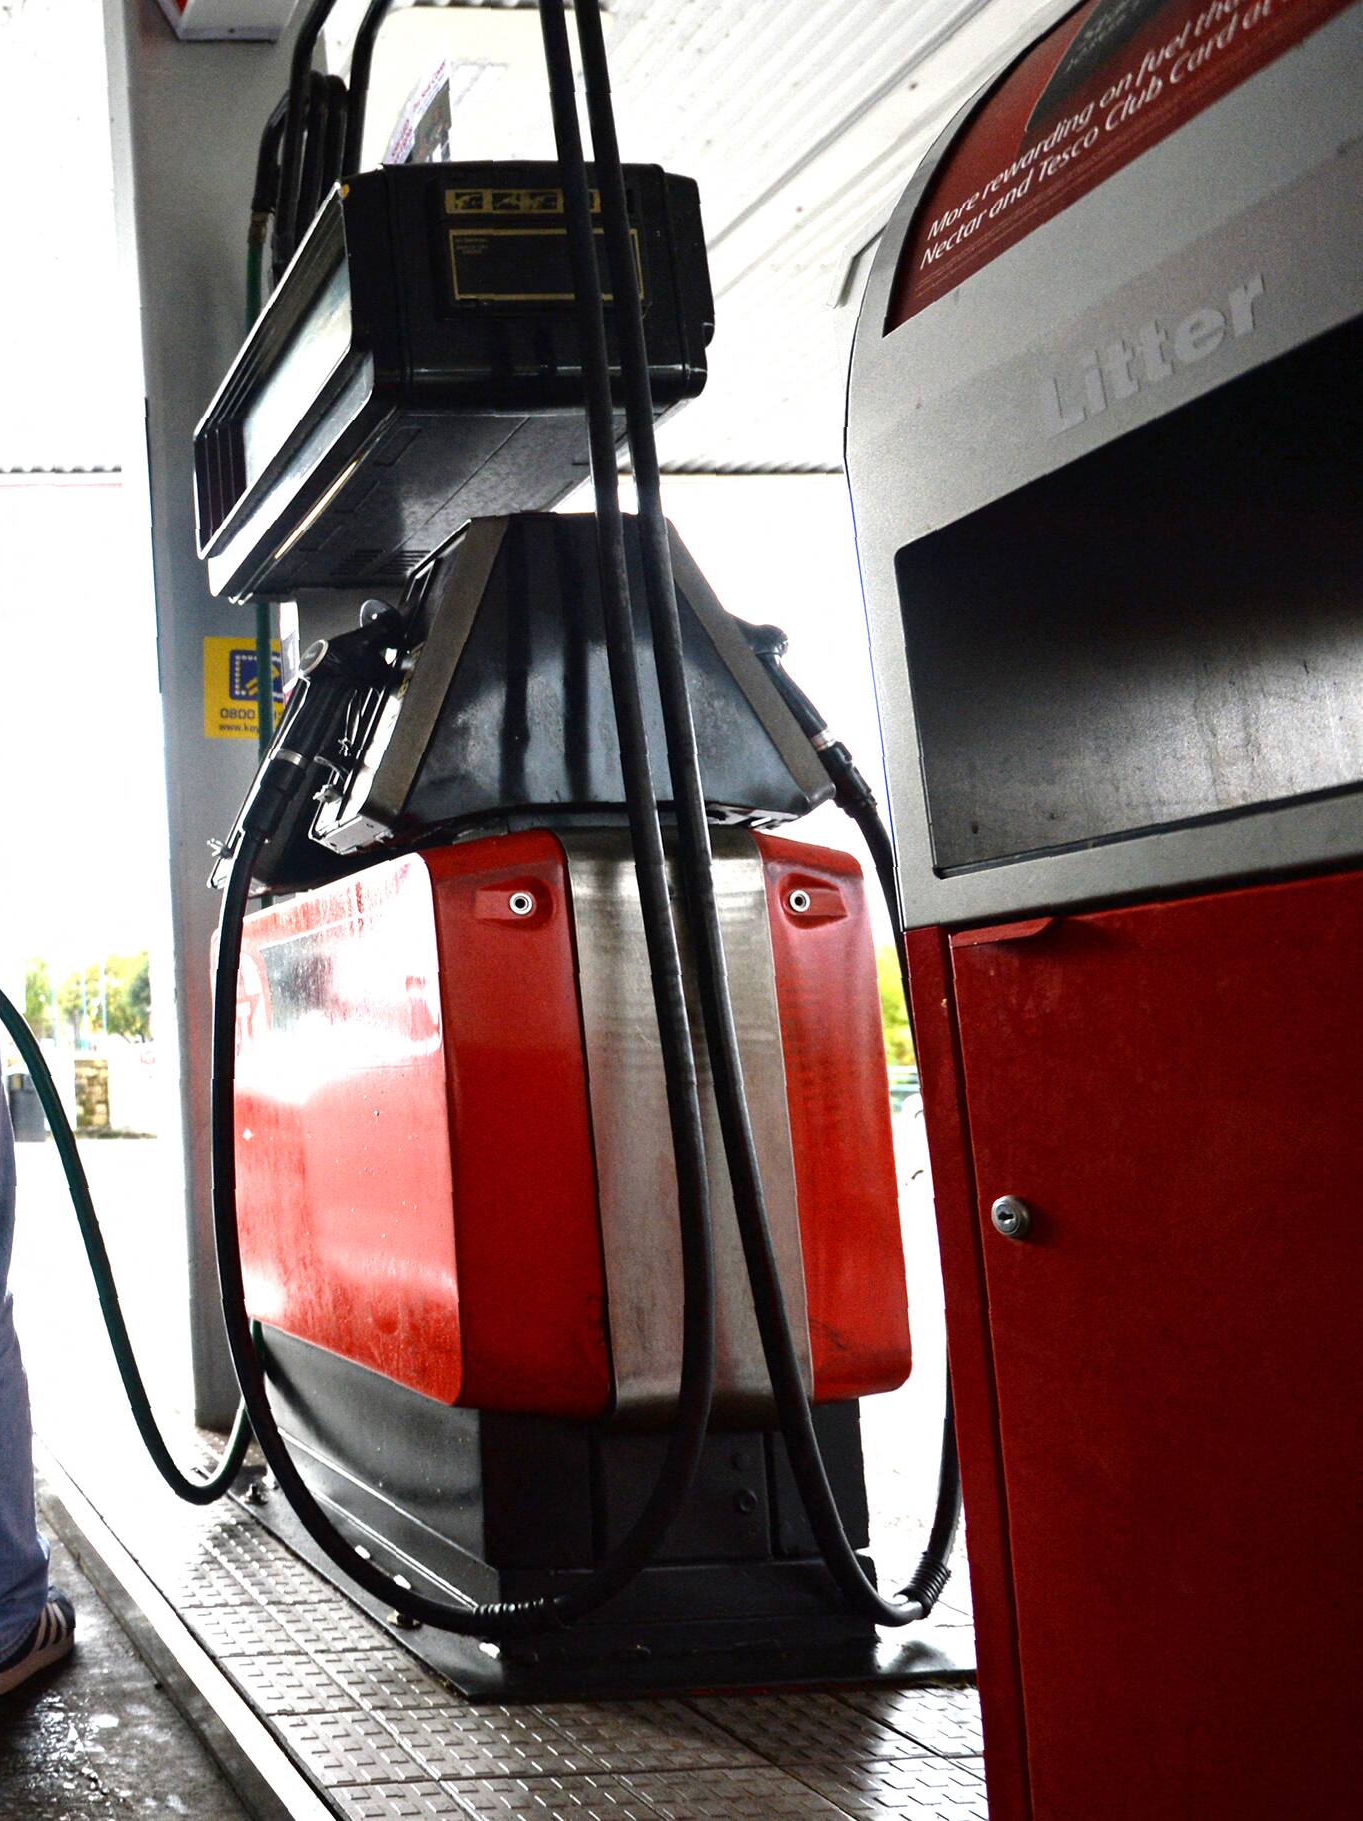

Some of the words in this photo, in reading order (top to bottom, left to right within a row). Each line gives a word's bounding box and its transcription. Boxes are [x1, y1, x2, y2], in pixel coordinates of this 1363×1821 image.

[920, 209, 988, 270] Nectar
[988, 170, 1032, 218] and
[1038, 128, 1099, 185] Tesco
[1105, 76, 1164, 130] Club
[1169, 11, 1238, 84] Card
[927, 191, 980, 241] More
[982, 101, 1094, 201] rewarding
[1099, 72, 1134, 109] on
[1135, 20, 1192, 87] fuel
[1040, 273, 1265, 439] Litter
[220, 707, 255, 719] 0800
